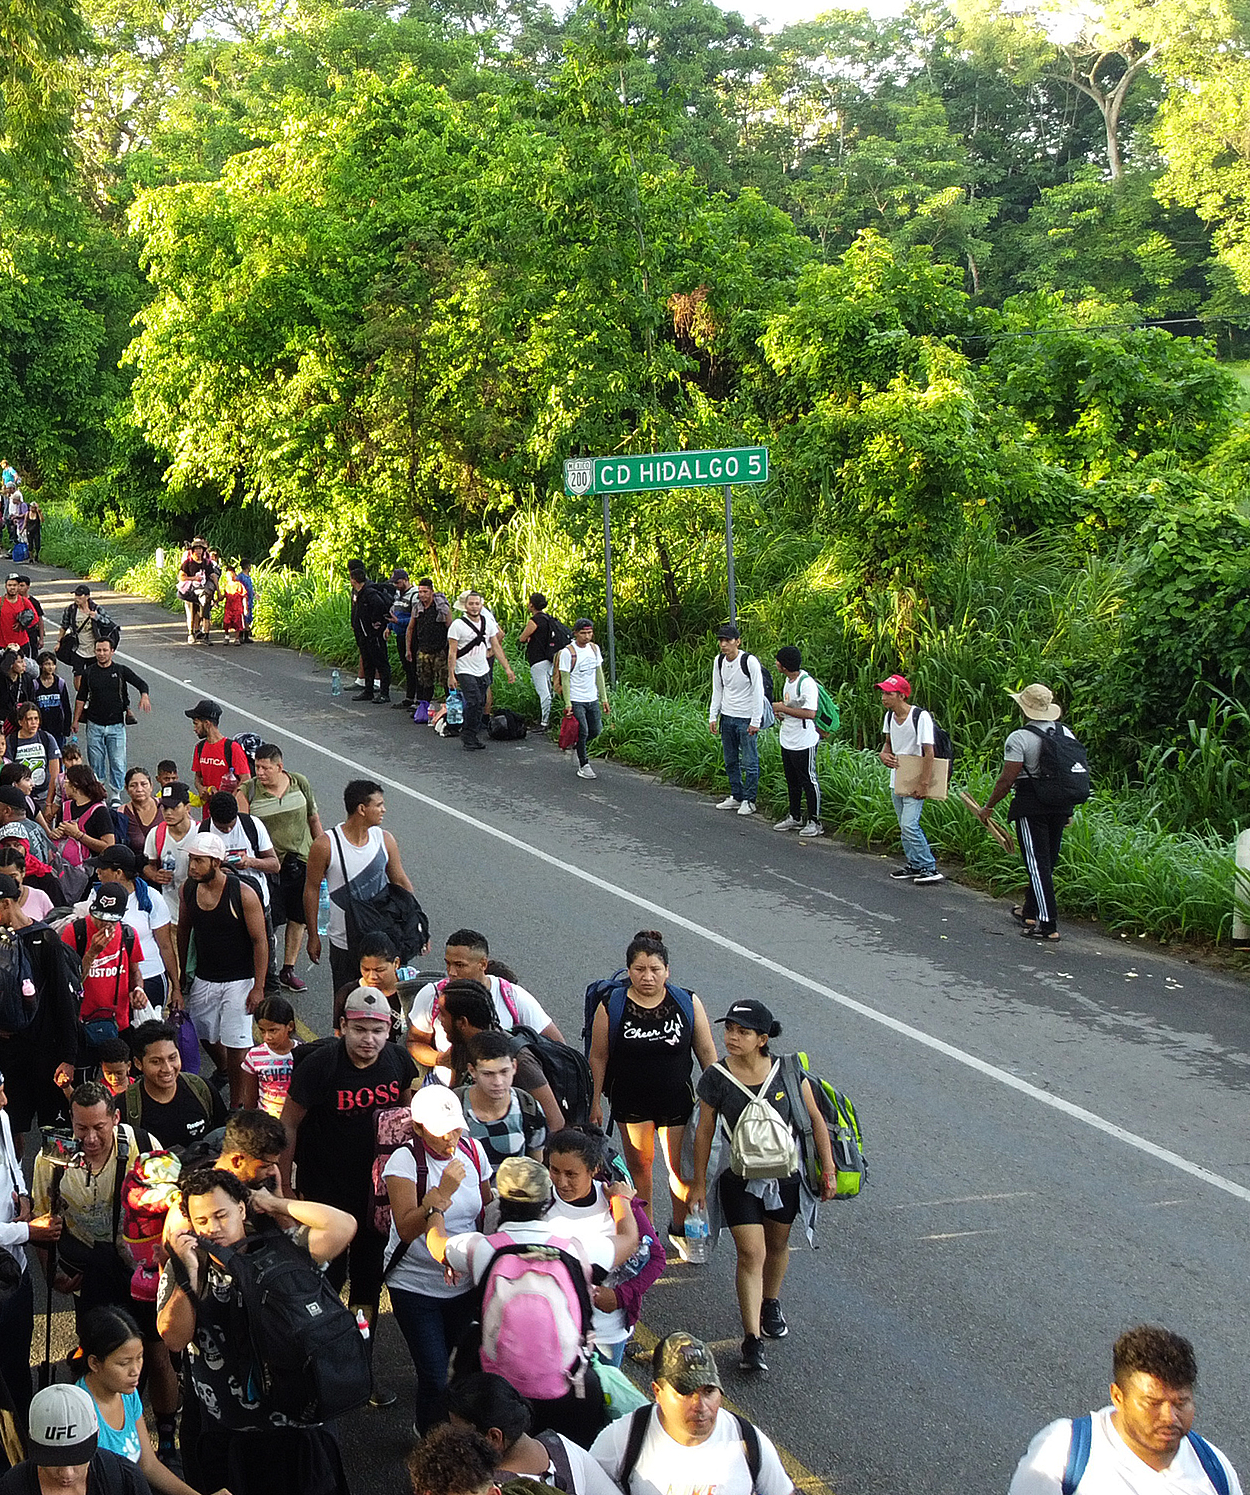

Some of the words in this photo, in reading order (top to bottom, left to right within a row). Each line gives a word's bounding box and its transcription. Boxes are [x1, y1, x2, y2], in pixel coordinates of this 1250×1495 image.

[600, 464, 631, 486] CD
[639, 456, 739, 482] HIDALGO
[749, 455, 762, 475] 5
[571, 472, 588, 488] 200
[88, 967, 106, 978] UST
[624, 1027, 661, 1038] Cheer
[336, 1080, 400, 1111] BOSS
[45, 1424, 77, 1440] UFC
